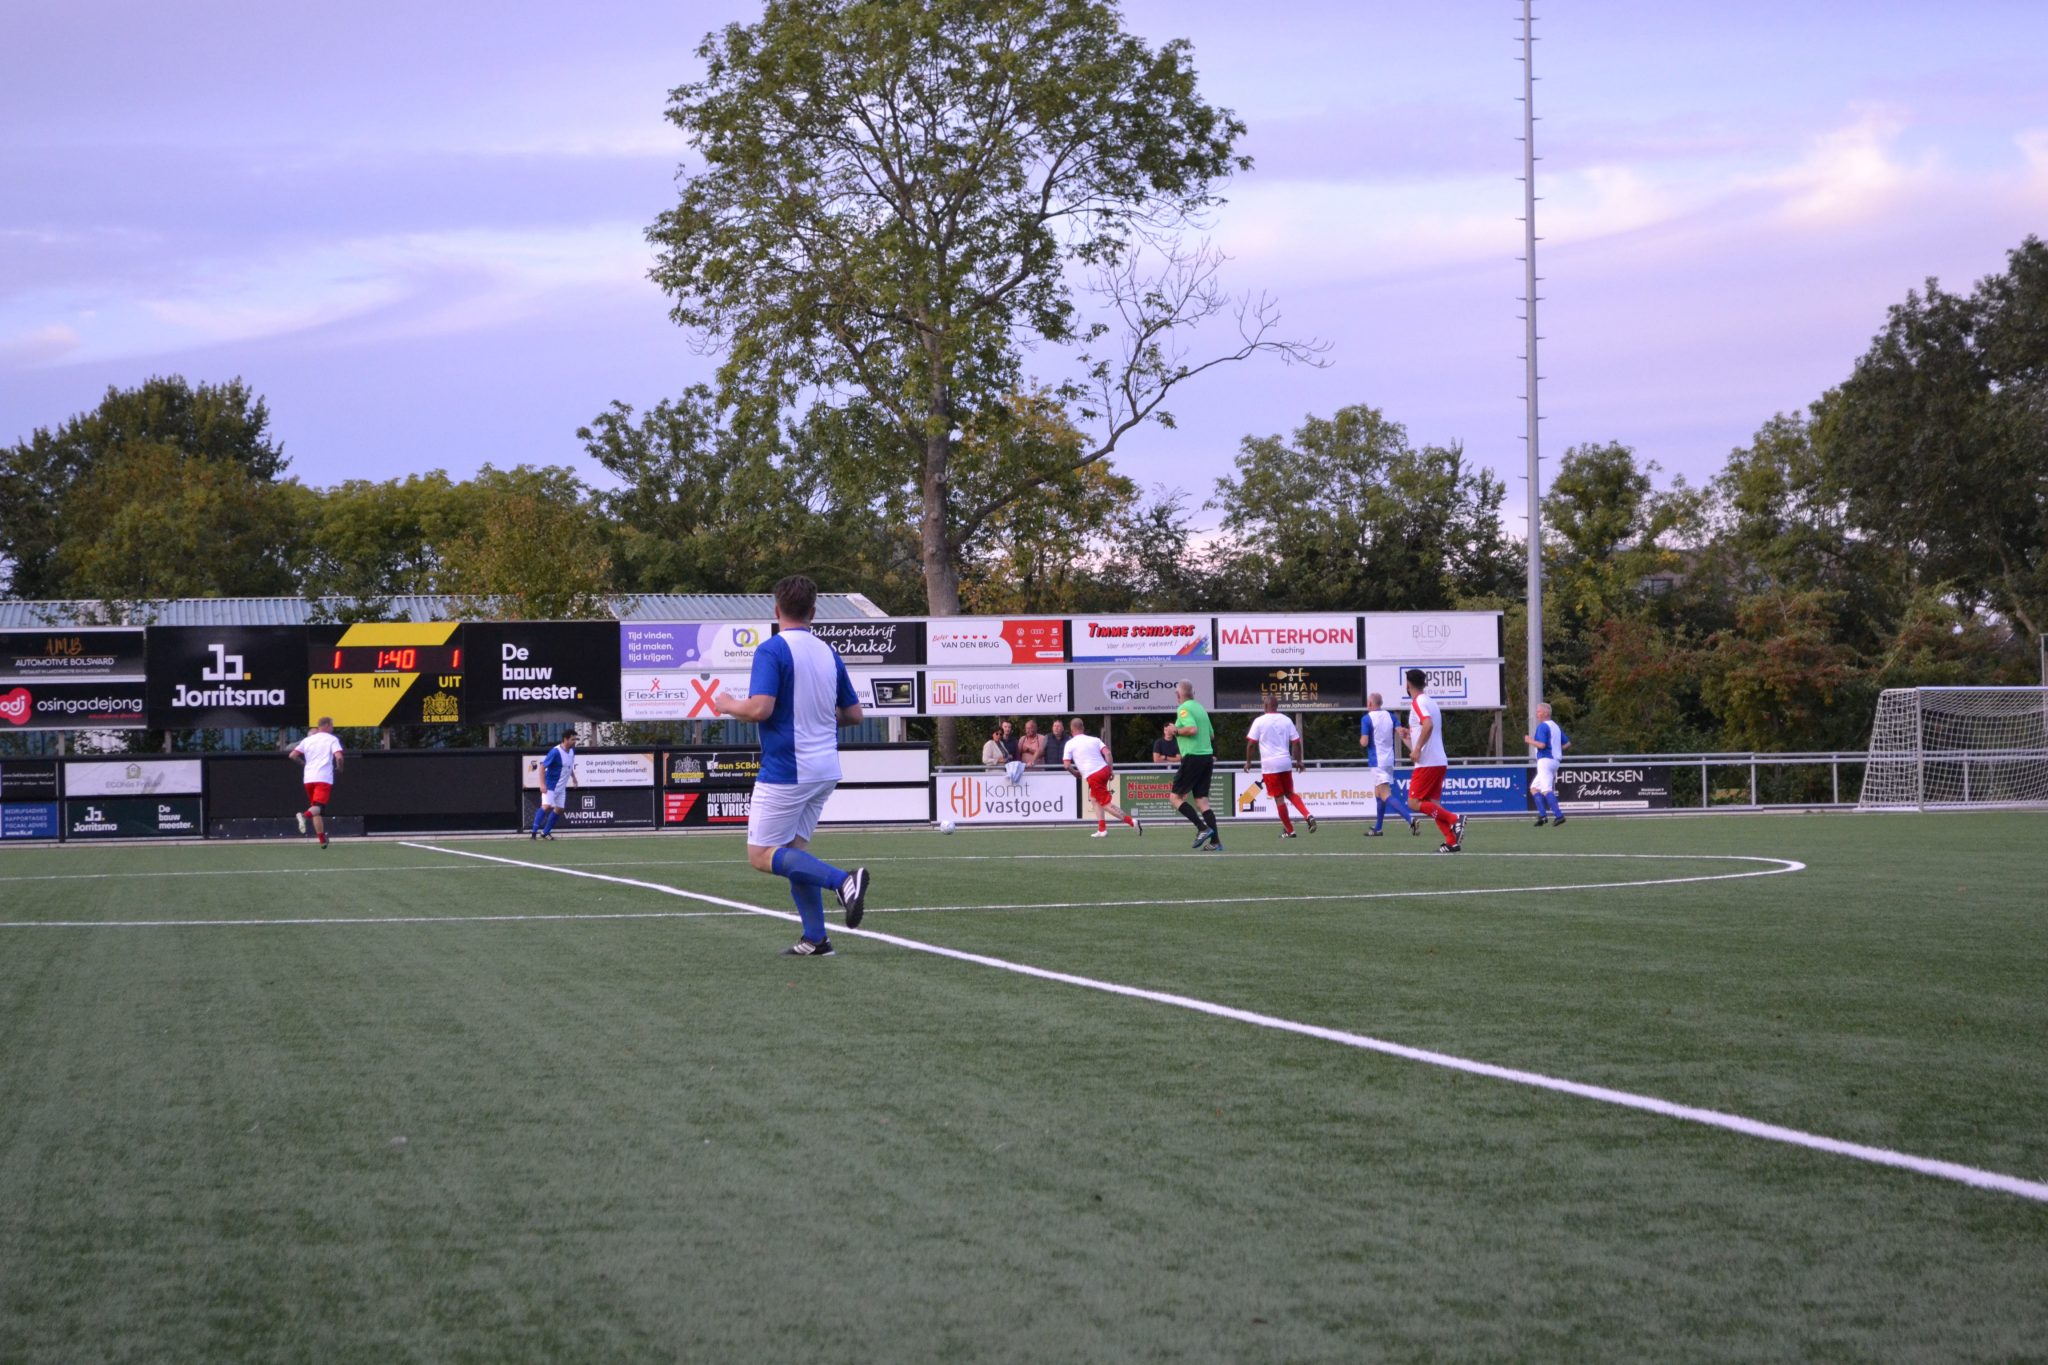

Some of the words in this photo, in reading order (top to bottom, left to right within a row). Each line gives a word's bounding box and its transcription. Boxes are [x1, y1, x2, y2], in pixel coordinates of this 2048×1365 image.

[628, 631, 642, 640] Tijd
[809, 625, 896, 641] hildersbedrijf
[1088, 623, 1129, 638] TIMME
[1131, 625, 1196, 637] SCHILDERS
[1221, 624, 1354, 645] MATTERHORN
[1412, 625, 1451, 639] BLEND
[502, 643, 529, 660] De
[628, 643, 642, 652] tijd
[830, 640, 896, 653] Schakel
[1271, 646, 1306, 655] coaching
[16, 658, 68, 668] AUTOMOTIVE
[70, 657, 115, 666] BOLSWARD
[333, 651, 341, 669] 1
[377, 649, 416, 669] 1:40
[452, 649, 461, 668] 1
[628, 653, 642, 662] tijd
[312, 678, 354, 689] THUIS
[373, 677, 401, 688] MIN
[439, 676, 462, 688] UIT
[960, 683, 1020, 691] Tegelgroothandel
[1123, 680, 1179, 691] Rijschoo
[1261, 682, 1318, 691] LOHMAN
[172, 684, 285, 707] Jorritsma
[502, 684, 584, 700] meester.
[628, 691, 685, 700] FlexFirst
[857, 690, 870, 698] OUW
[960, 694, 991, 704] Julius
[1016, 694, 1034, 703] der
[1036, 692, 1062, 703] Werf
[1110, 690, 1150, 700] Richard
[0, 695, 26, 716] odj
[37, 697, 143, 713] osingadejong
[735, 761, 761, 770] SCBol
[1555, 770, 1643, 783] HENDRIKSEN
[985, 781, 1030, 798] komt
[1341, 788, 1374, 799] Rinse
[1577, 784, 1622, 799] Fashion
[708, 793, 751, 804] AUTOBEDRIJF
[158, 805, 170, 813] De
[708, 804, 720, 817] DE
[722, 803, 750, 817] VRIES
[985, 795, 1063, 817] vastgoed
[73, 823, 117, 832] Jorritsma
[158, 821, 194, 830] meester.
